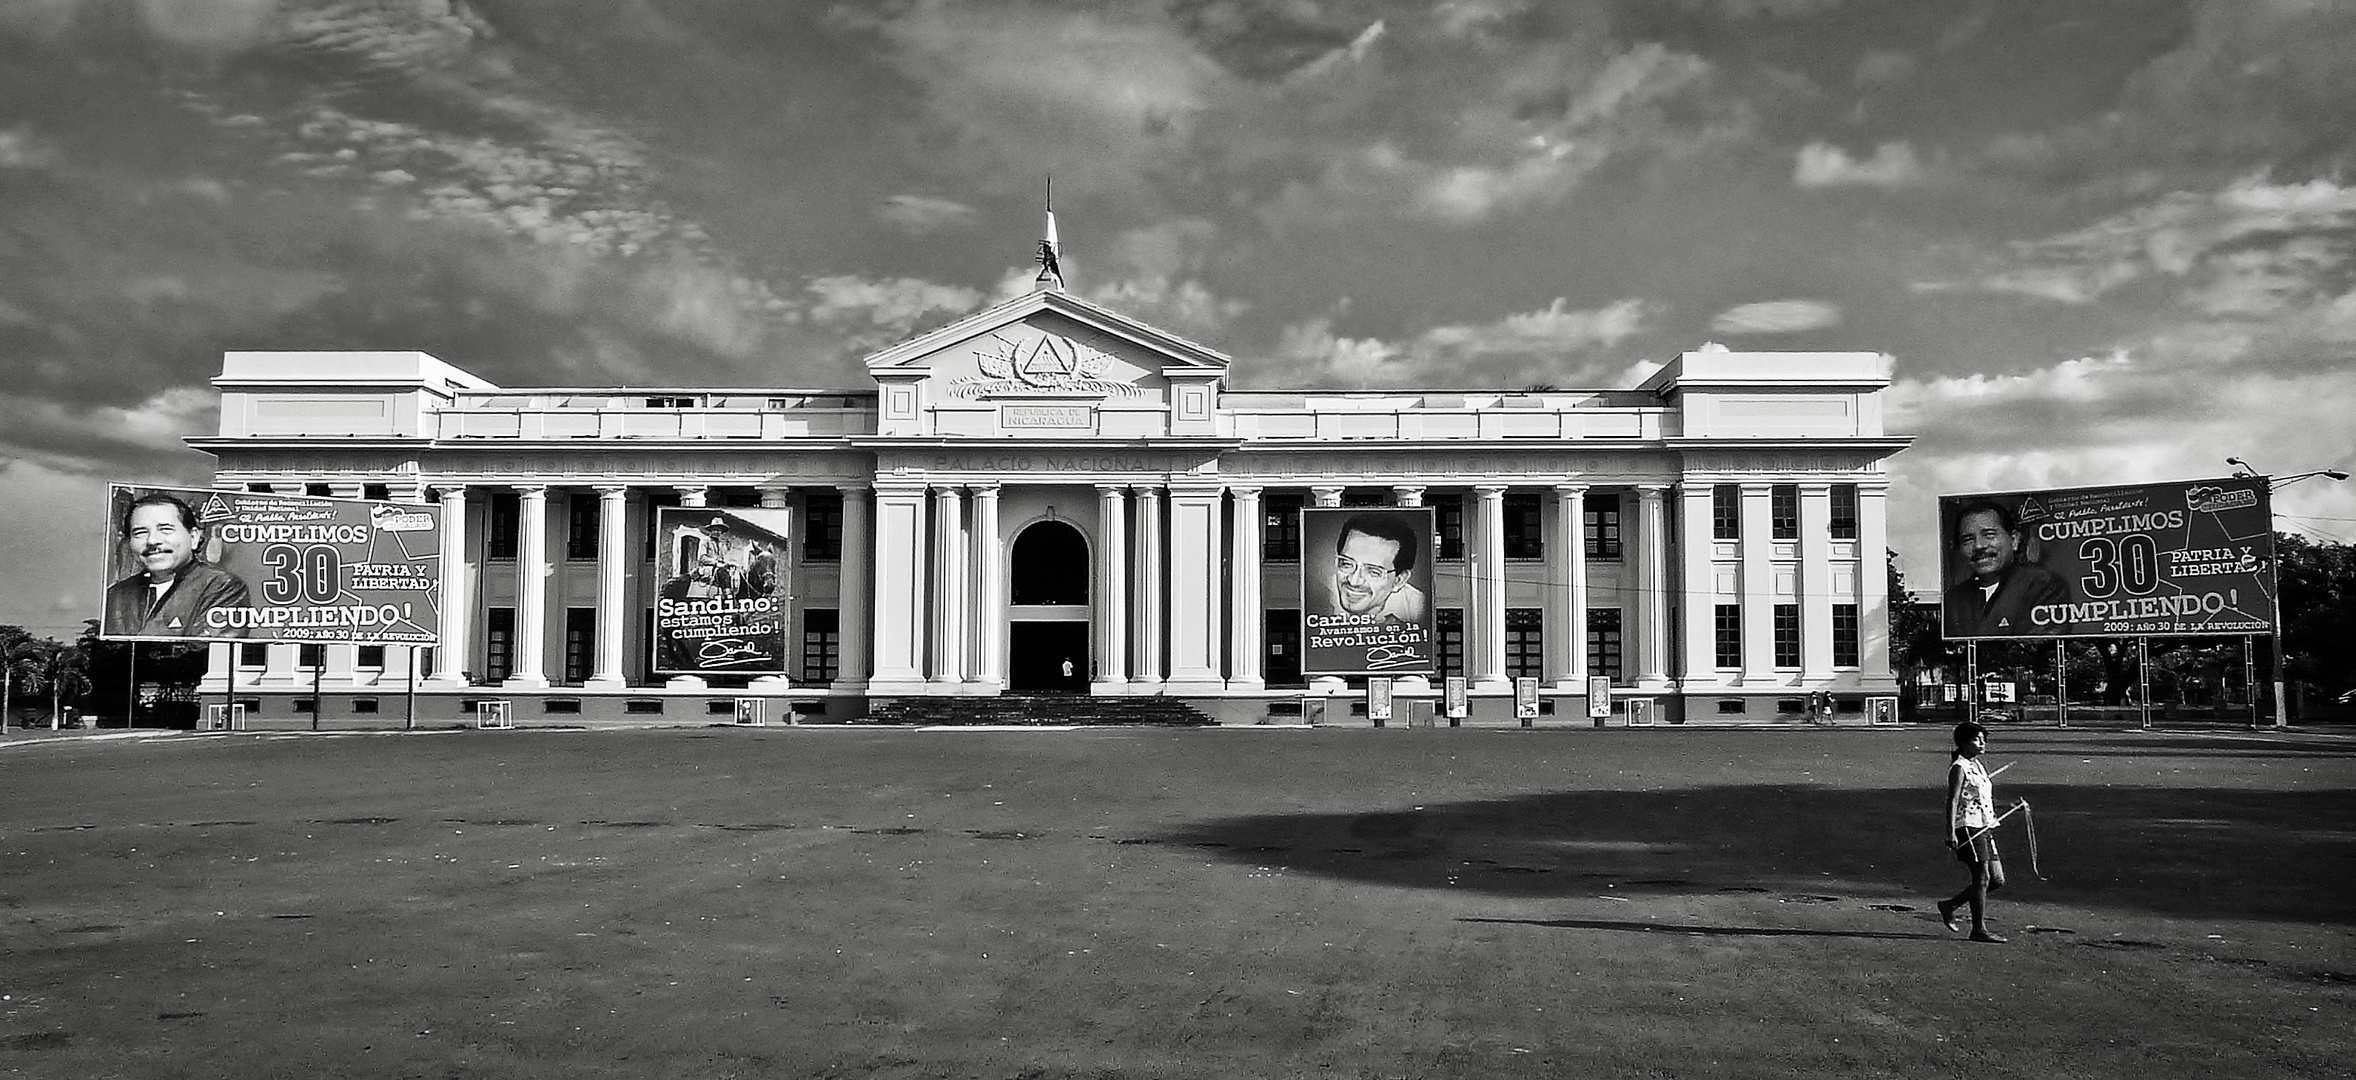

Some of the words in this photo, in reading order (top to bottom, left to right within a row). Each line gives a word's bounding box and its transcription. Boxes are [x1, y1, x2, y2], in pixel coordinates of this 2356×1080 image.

[1008, 417, 1084, 426] NICARAGUA
[935, 455, 1031, 472] PALACIO
[1046, 455, 1159, 472] NACIONAL
[2212, 491, 2253, 503] PODER
[395, 515, 430, 523] PODER
[2038, 510, 2183, 541] CUMPLIMOS
[221, 524, 368, 543] CUMPLIMOS
[2171, 548, 2235, 563] PATRIA
[262, 543, 342, 605] 30
[353, 564, 411, 576] PATRIA
[415, 565, 427, 577] Y
[2079, 533, 2159, 599] 30
[2170, 560, 2267, 577] LIBERTA!
[351, 577, 438, 591] LIBERTAD!
[659, 595, 779, 617] Sandino:
[2031, 589, 2237, 625] CUMPLIENDO!
[206, 603, 412, 628] CUMPLIENDO!
[660, 614, 733, 628] estamos
[1306, 612, 1376, 627] Carlos:
[282, 628, 314, 639] 2009:
[336, 630, 349, 639] 30
[352, 632, 363, 640] DE
[366, 632, 381, 640] LA
[672, 621, 780, 641] cumpliendo!
[1319, 625, 1380, 636] Avanzamos
[1406, 623, 1420, 631] la
[2103, 622, 2134, 632] 2009:
[2157, 621, 2170, 631] 30
[2174, 622, 2186, 630] DE
[2190, 622, 2205, 630] LA
[1310, 629, 1428, 648] Revolución!
